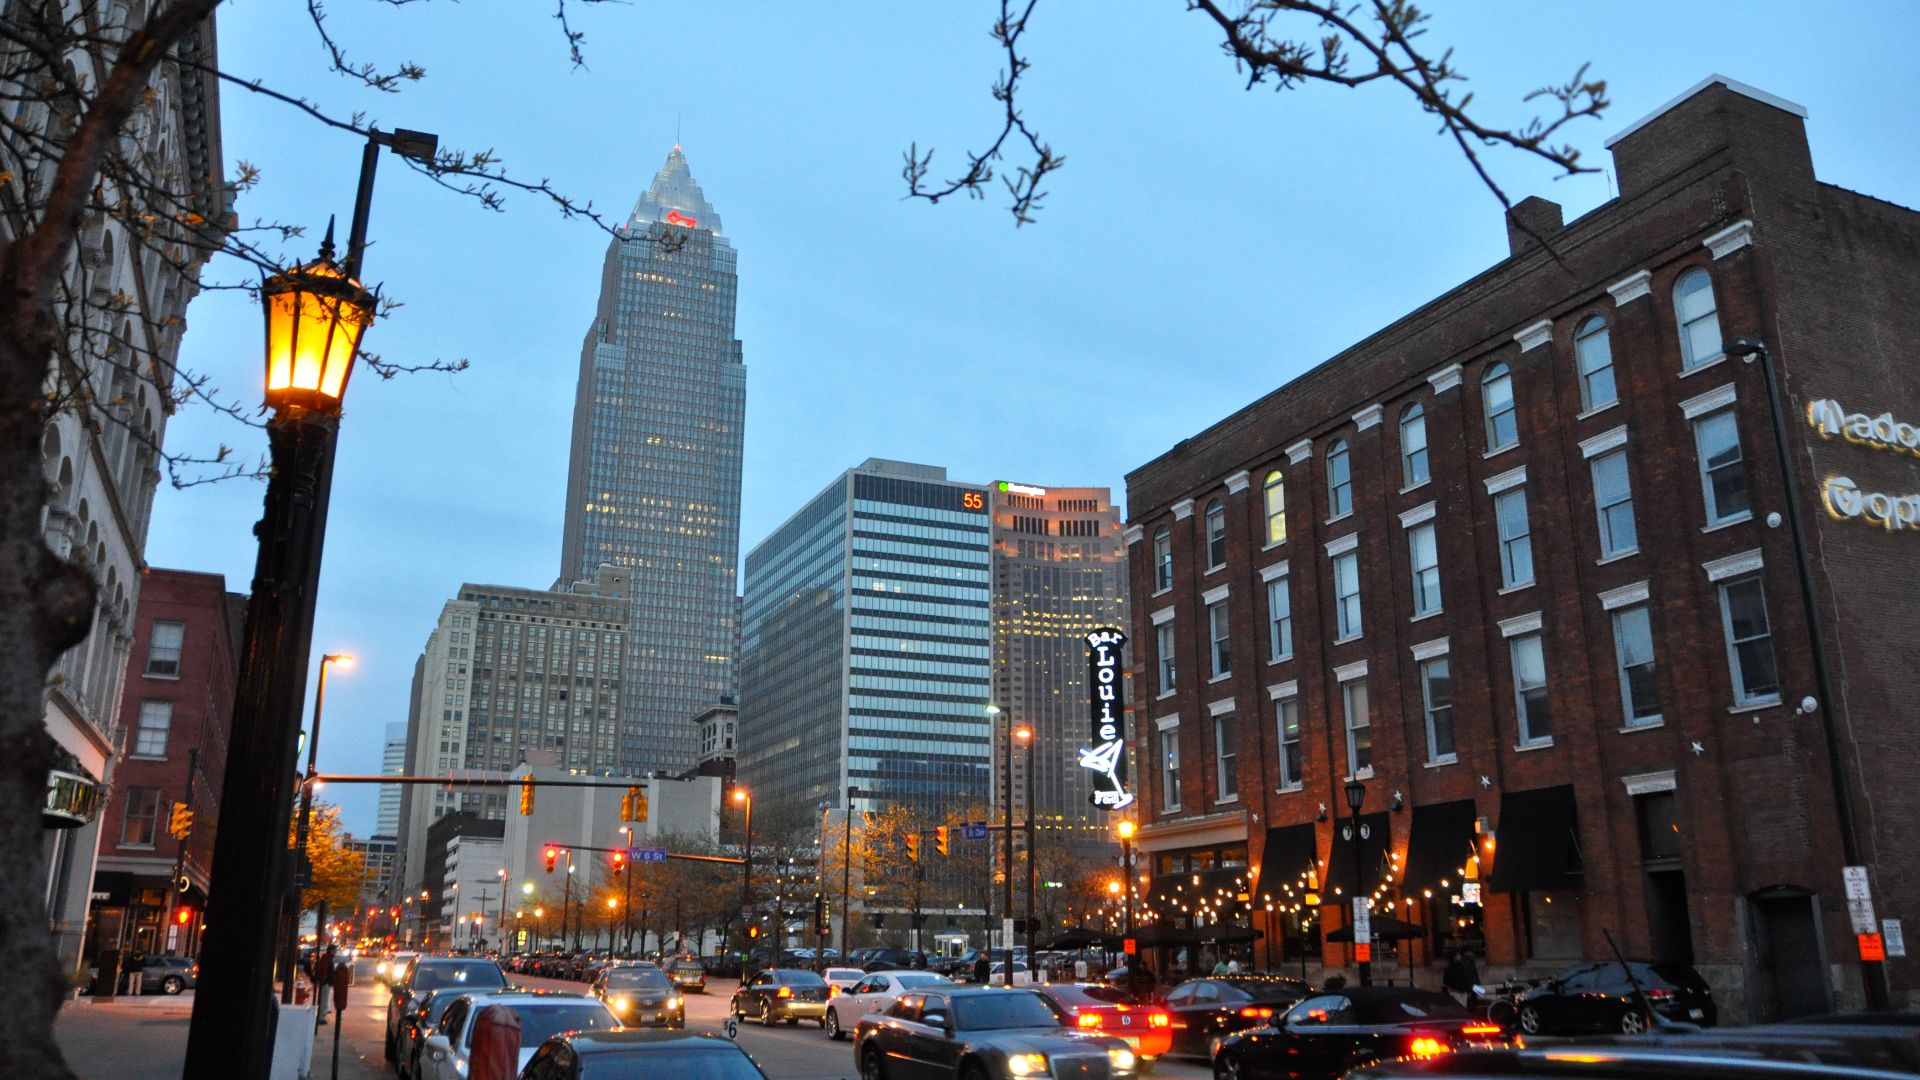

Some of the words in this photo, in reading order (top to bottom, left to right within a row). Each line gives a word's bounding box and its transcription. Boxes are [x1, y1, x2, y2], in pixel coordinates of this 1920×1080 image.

[963, 492, 983, 509] 55
[1087, 632, 1123, 648] Bar
[1097, 646, 1116, 741] Louie
[631, 851, 642, 860] W
